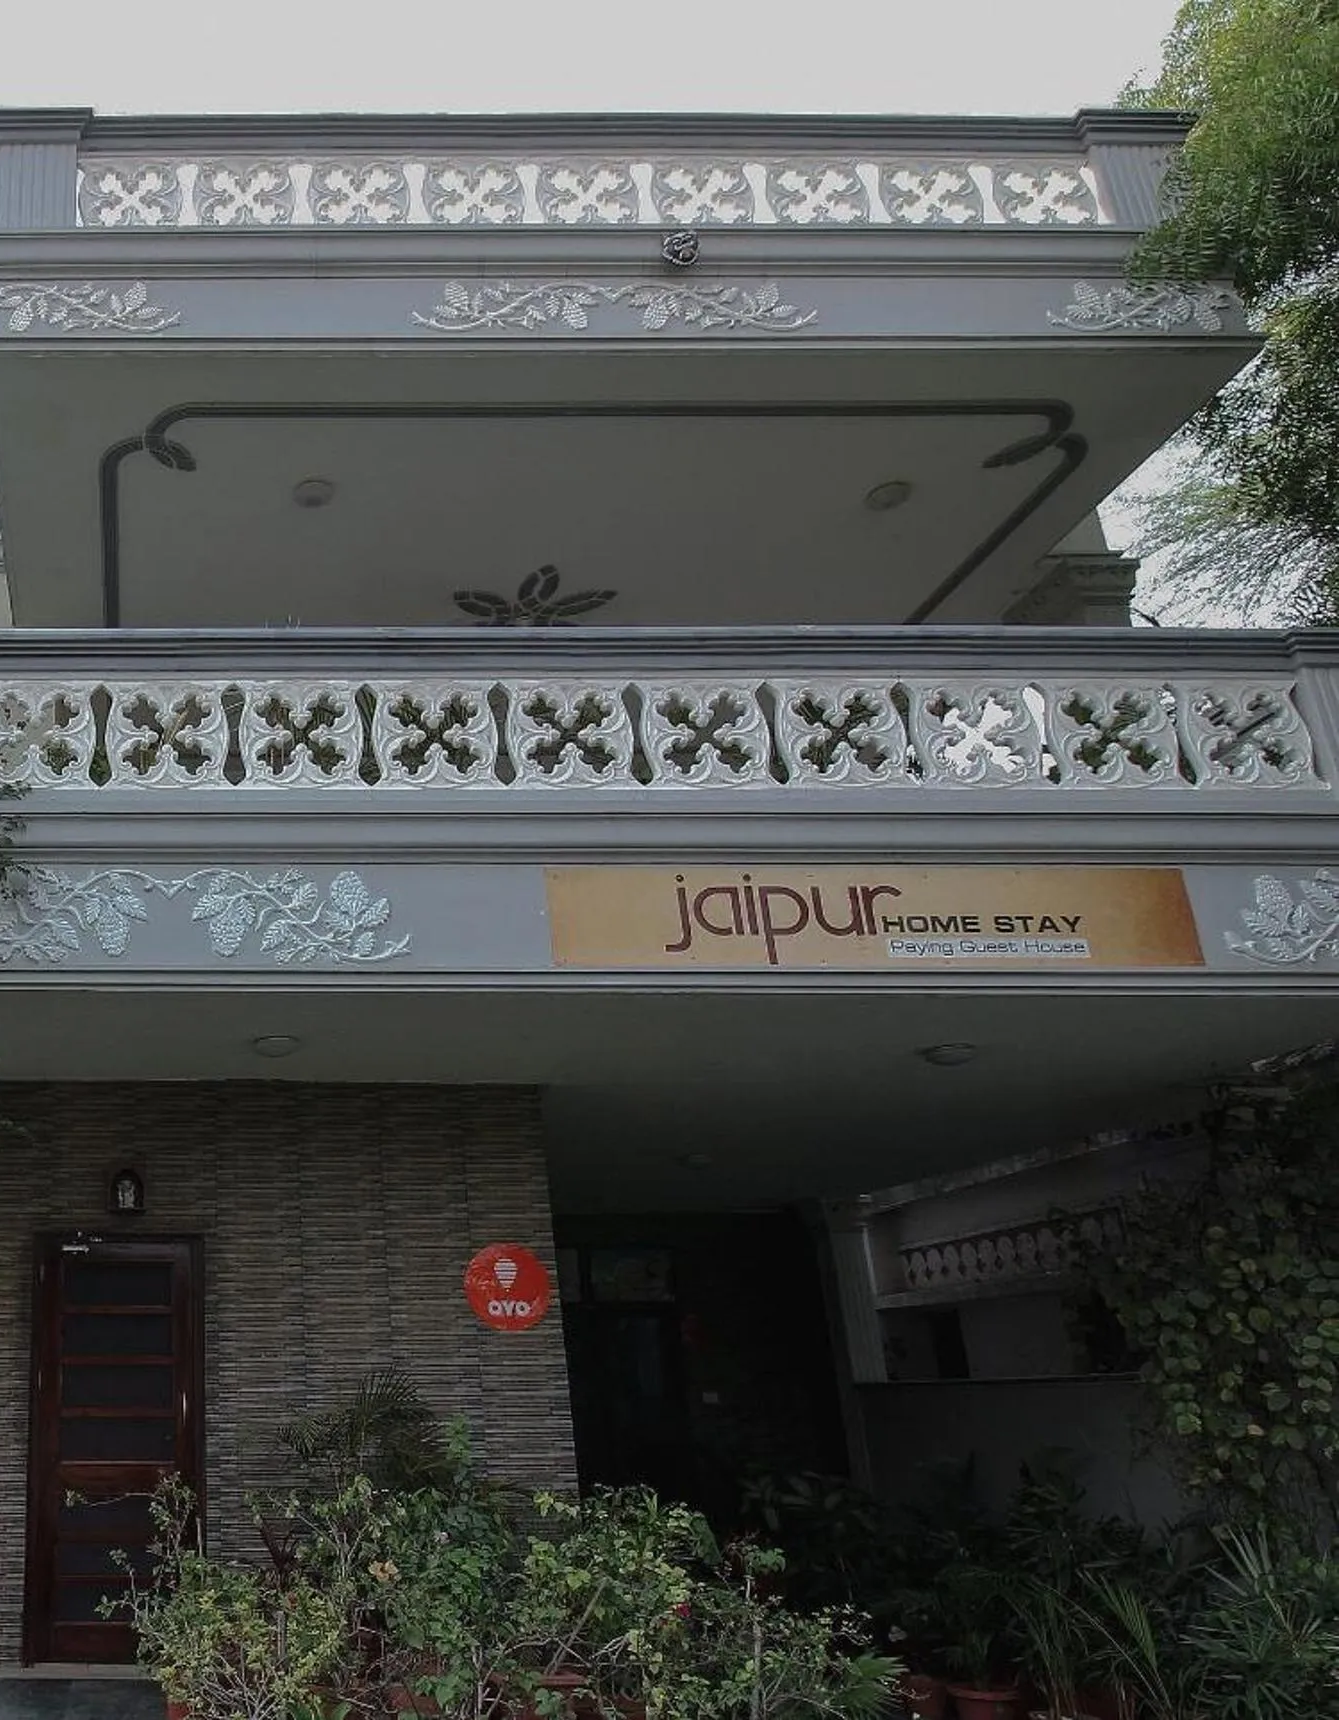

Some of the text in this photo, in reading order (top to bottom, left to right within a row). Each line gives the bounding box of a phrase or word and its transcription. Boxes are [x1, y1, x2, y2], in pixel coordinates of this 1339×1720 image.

[664, 873, 1082, 965] jaipur HOME STAY
[890, 939, 1087, 957] Paying Guest House
[487, 1300, 531, 1318] OYO
